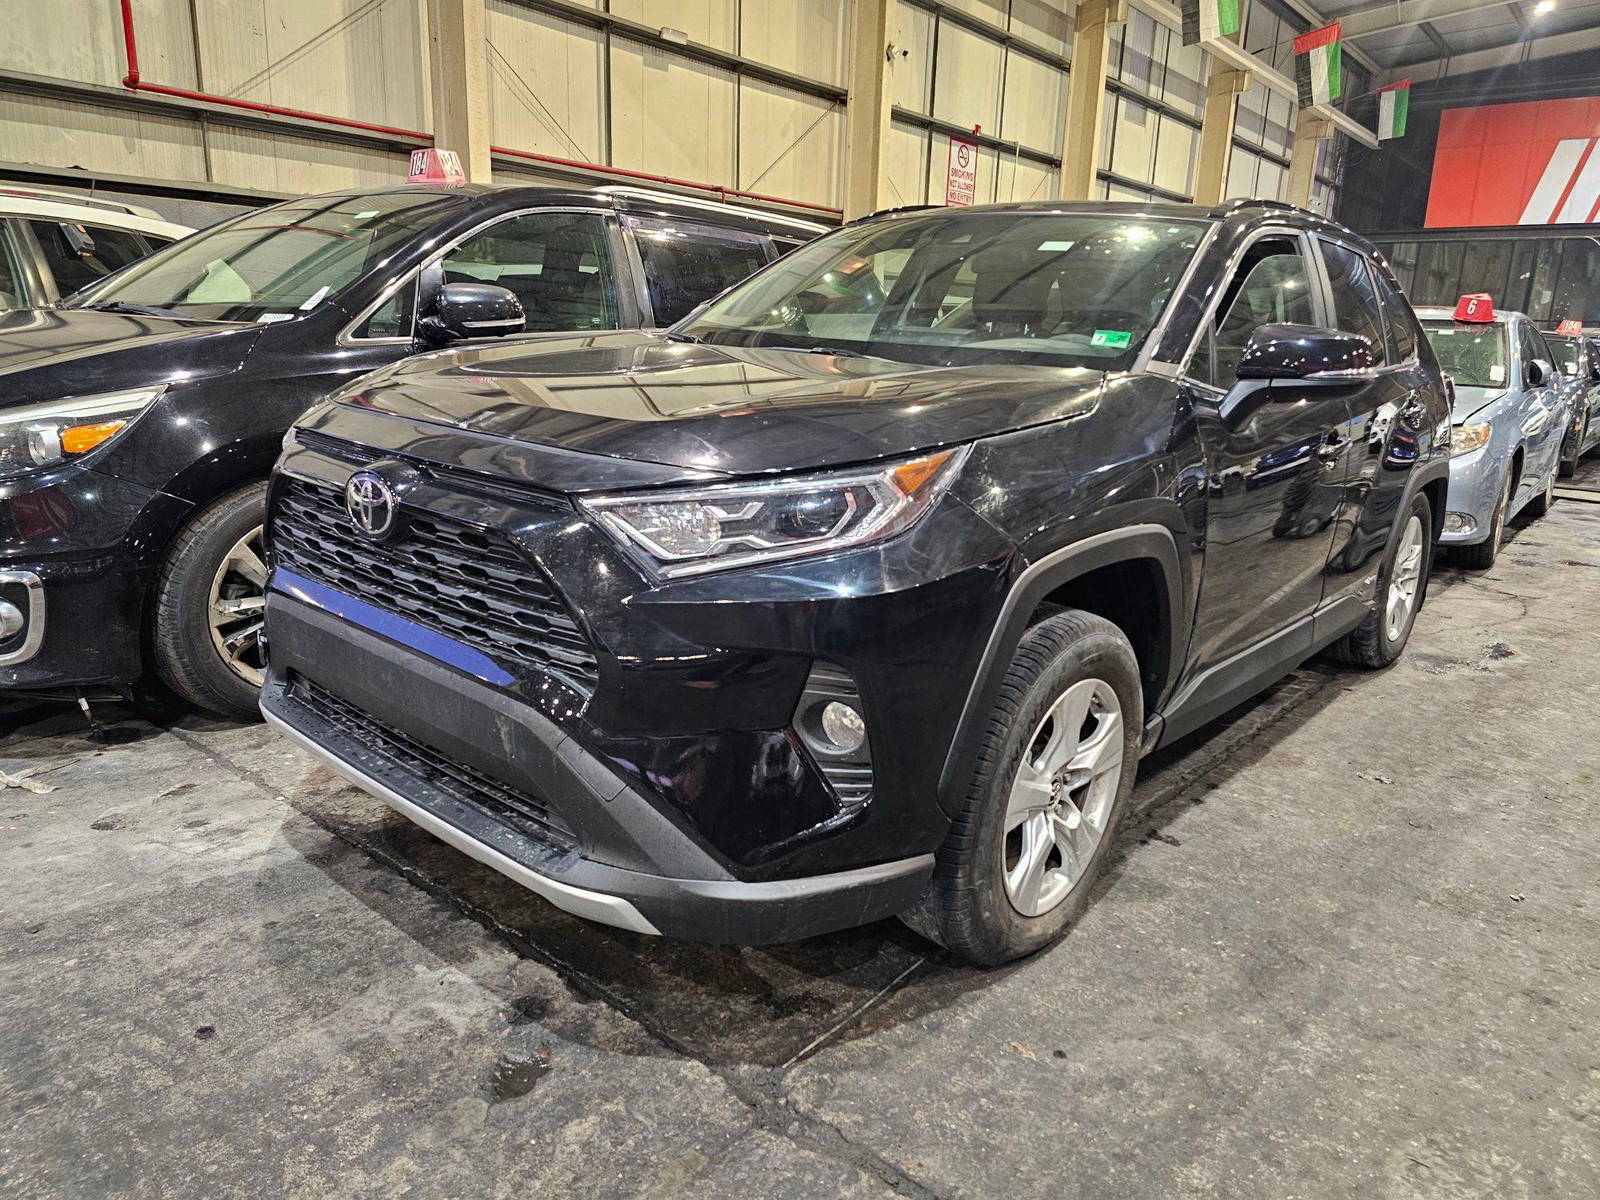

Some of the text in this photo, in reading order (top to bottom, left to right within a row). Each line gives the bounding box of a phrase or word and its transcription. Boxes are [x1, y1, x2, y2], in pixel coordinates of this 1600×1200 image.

[410, 151, 428, 176] 184
[440, 150, 463, 176] 184
[950, 167, 974, 182] SMOKING
[949, 191, 972, 203] NO ENTRY
[1467, 299, 1477, 314] 6
